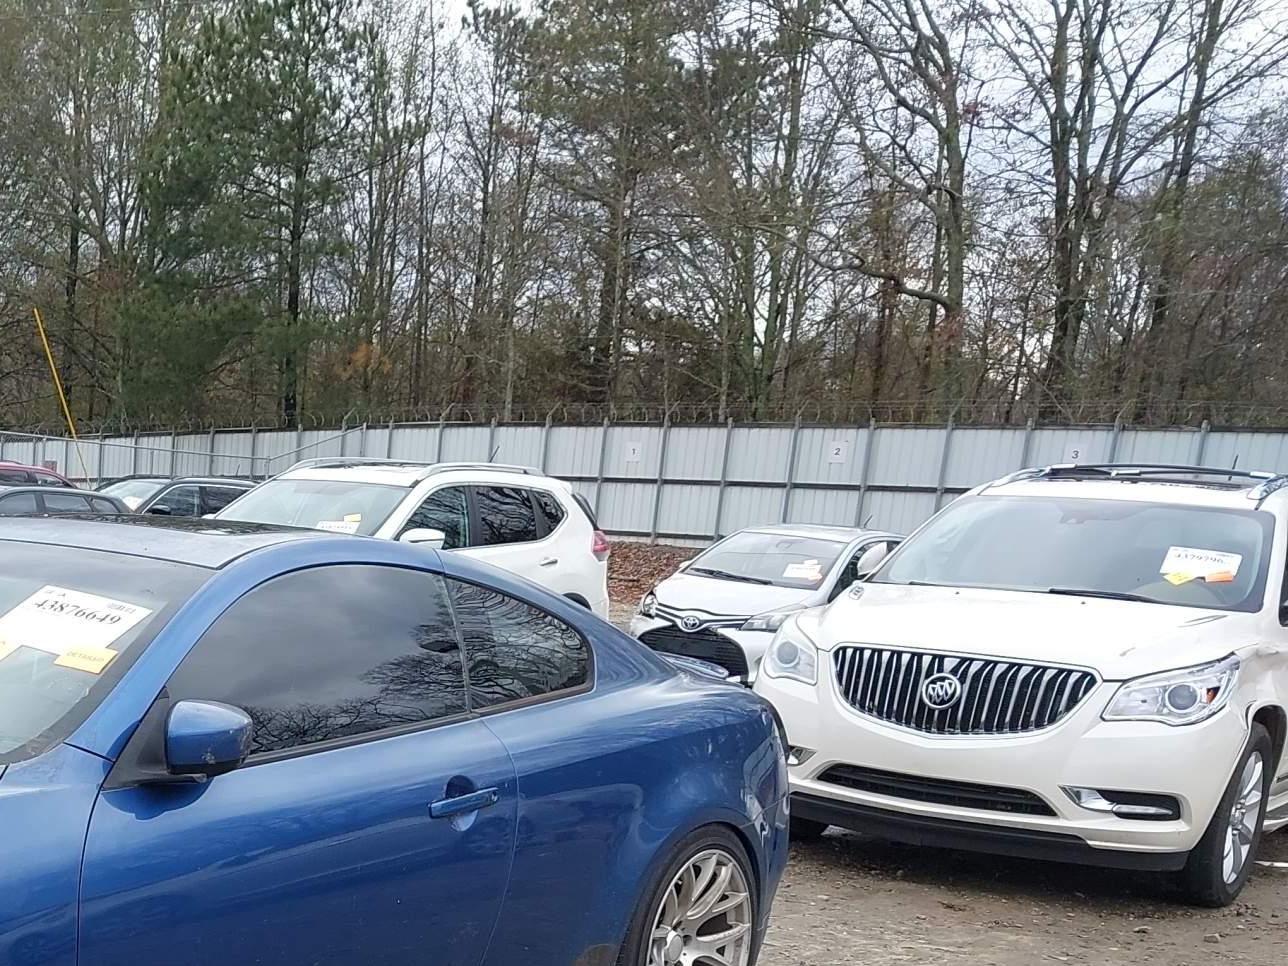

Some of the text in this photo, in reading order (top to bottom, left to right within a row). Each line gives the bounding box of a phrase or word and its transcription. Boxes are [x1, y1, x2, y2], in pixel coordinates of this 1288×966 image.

[833, 447, 841, 456] 2
[1071, 450, 1080, 459] 3
[34, 599, 123, 625] 43876649
